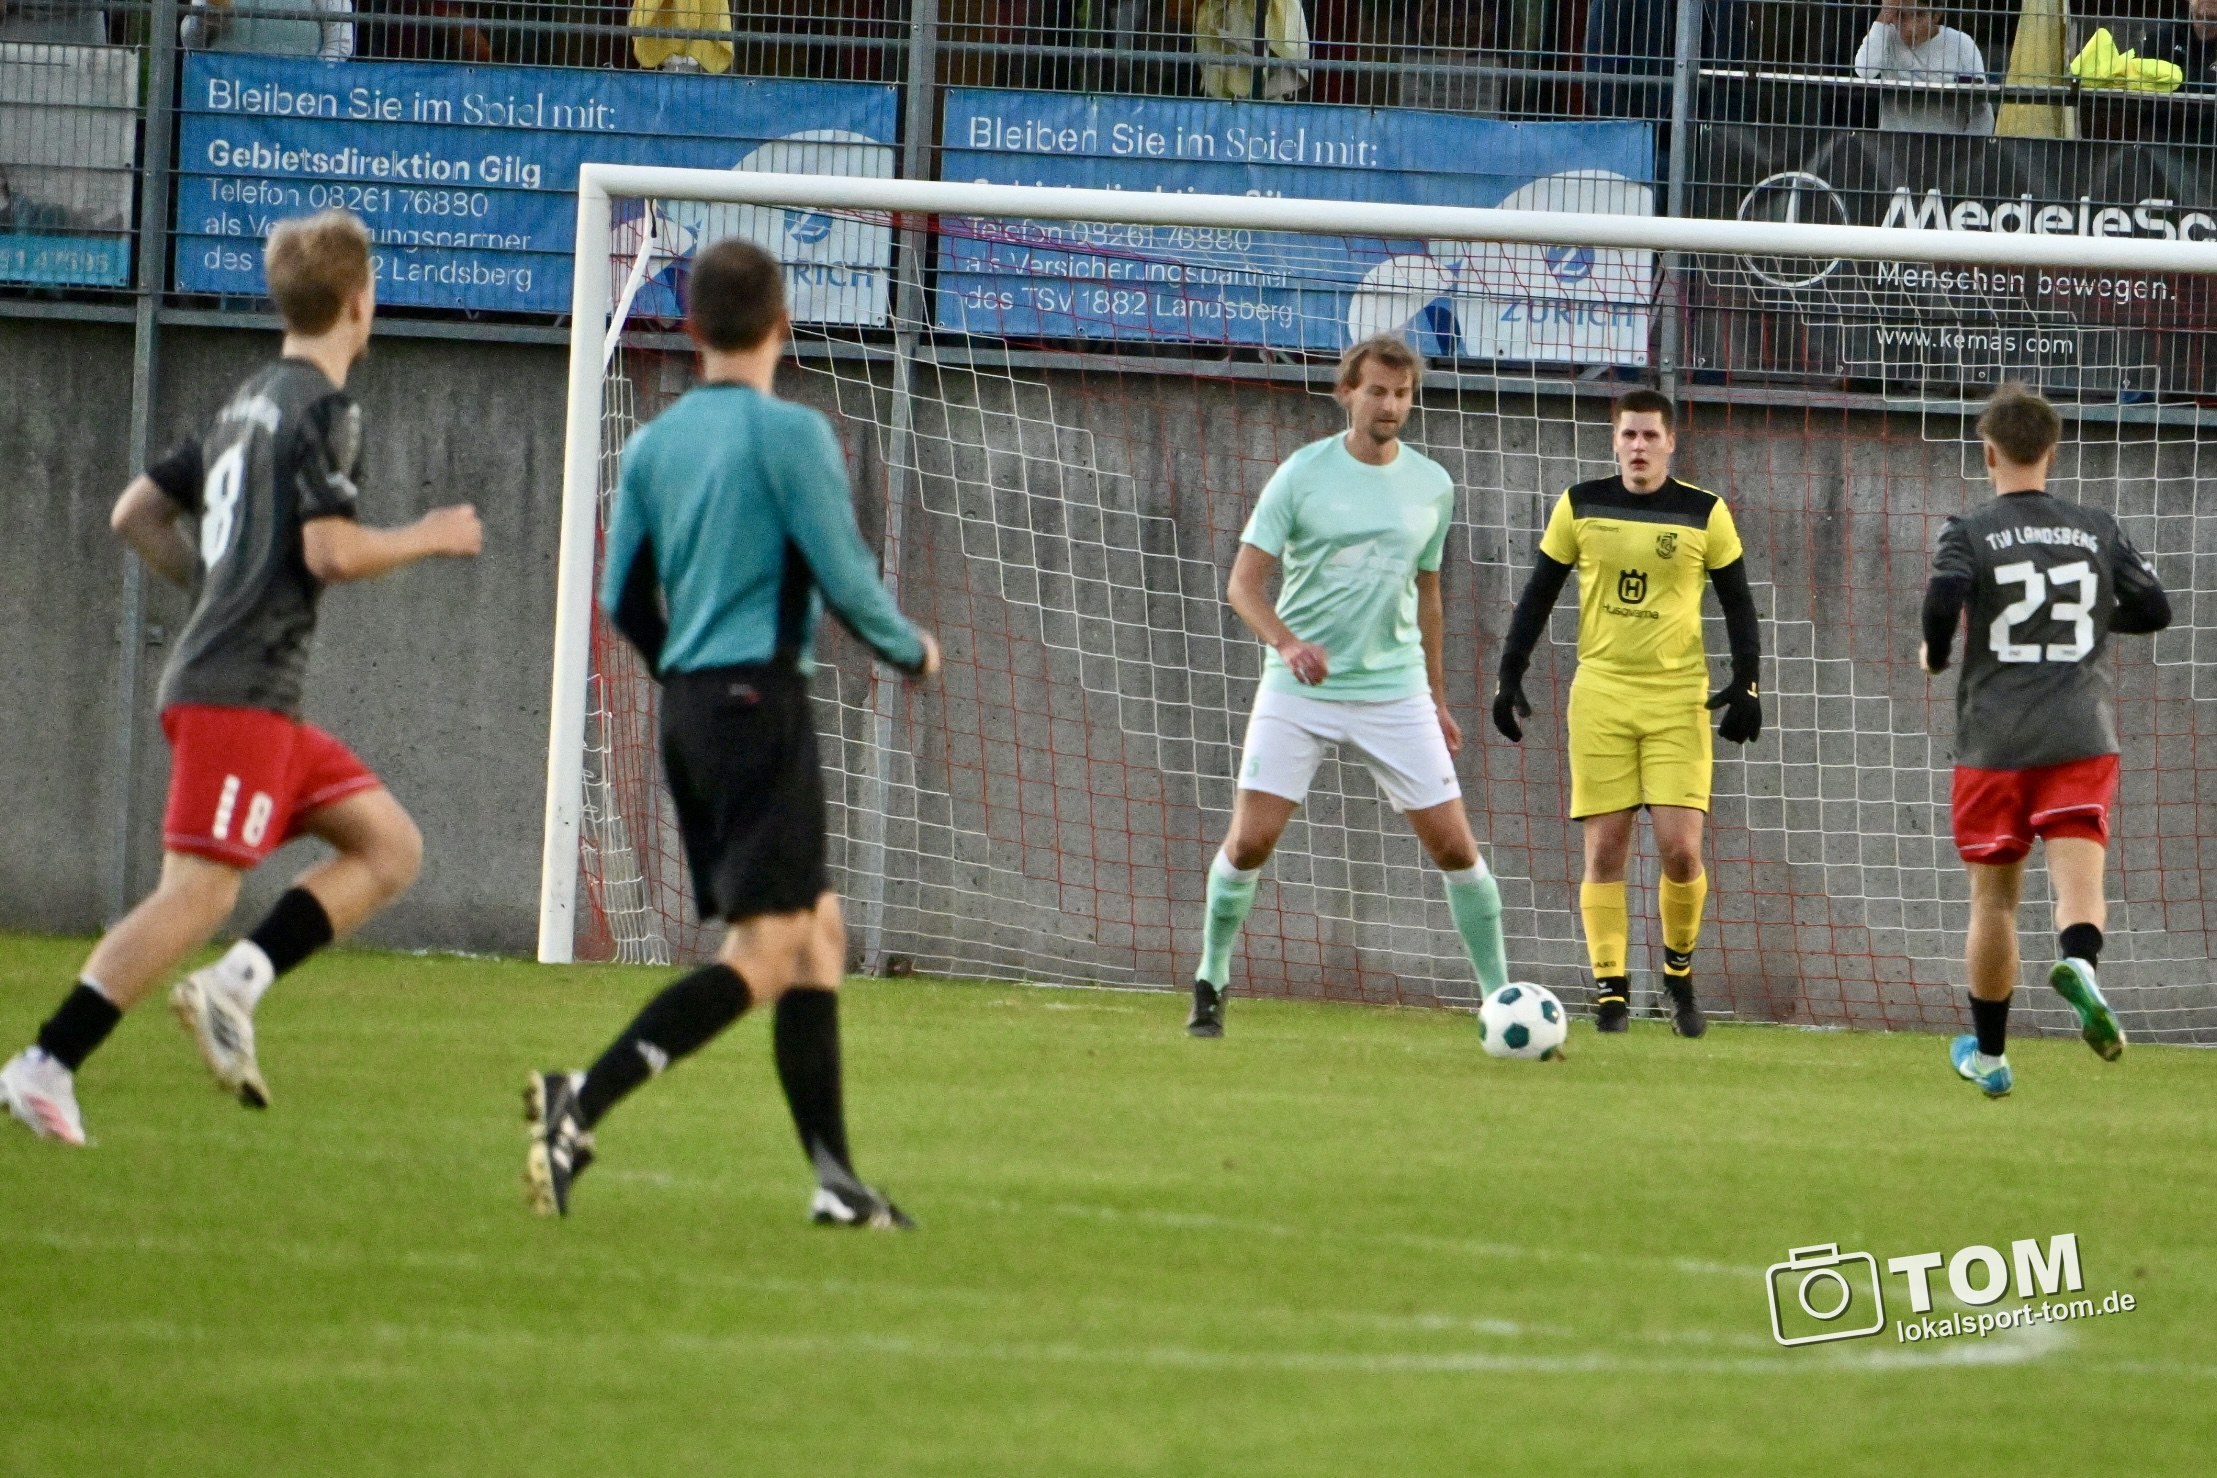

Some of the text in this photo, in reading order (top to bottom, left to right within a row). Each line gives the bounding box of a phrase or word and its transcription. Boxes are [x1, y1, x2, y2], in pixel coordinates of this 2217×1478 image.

[208, 78, 615, 129] Bleiben Sie im Spiel mit:
[208, 138, 541, 190] Gebietsdirektion Gilg
[970, 116, 1377, 167] Bleiben Sie im Spiel mit:
[206, 177, 301, 208] Telefon
[205, 211, 241, 237] als
[204, 246, 253, 272] des
[392, 257, 532, 293] Landsberg
[780, 260, 874, 288] RICH
[1010, 252, 1292, 290] Versicherungspartner
[1877, 260, 2177, 305] Menschen bewegen.
[964, 284, 1293, 329] des TSV 1882 Landsberg
[1989, 560, 2098, 663] 23
[212, 773, 274, 848] 18
